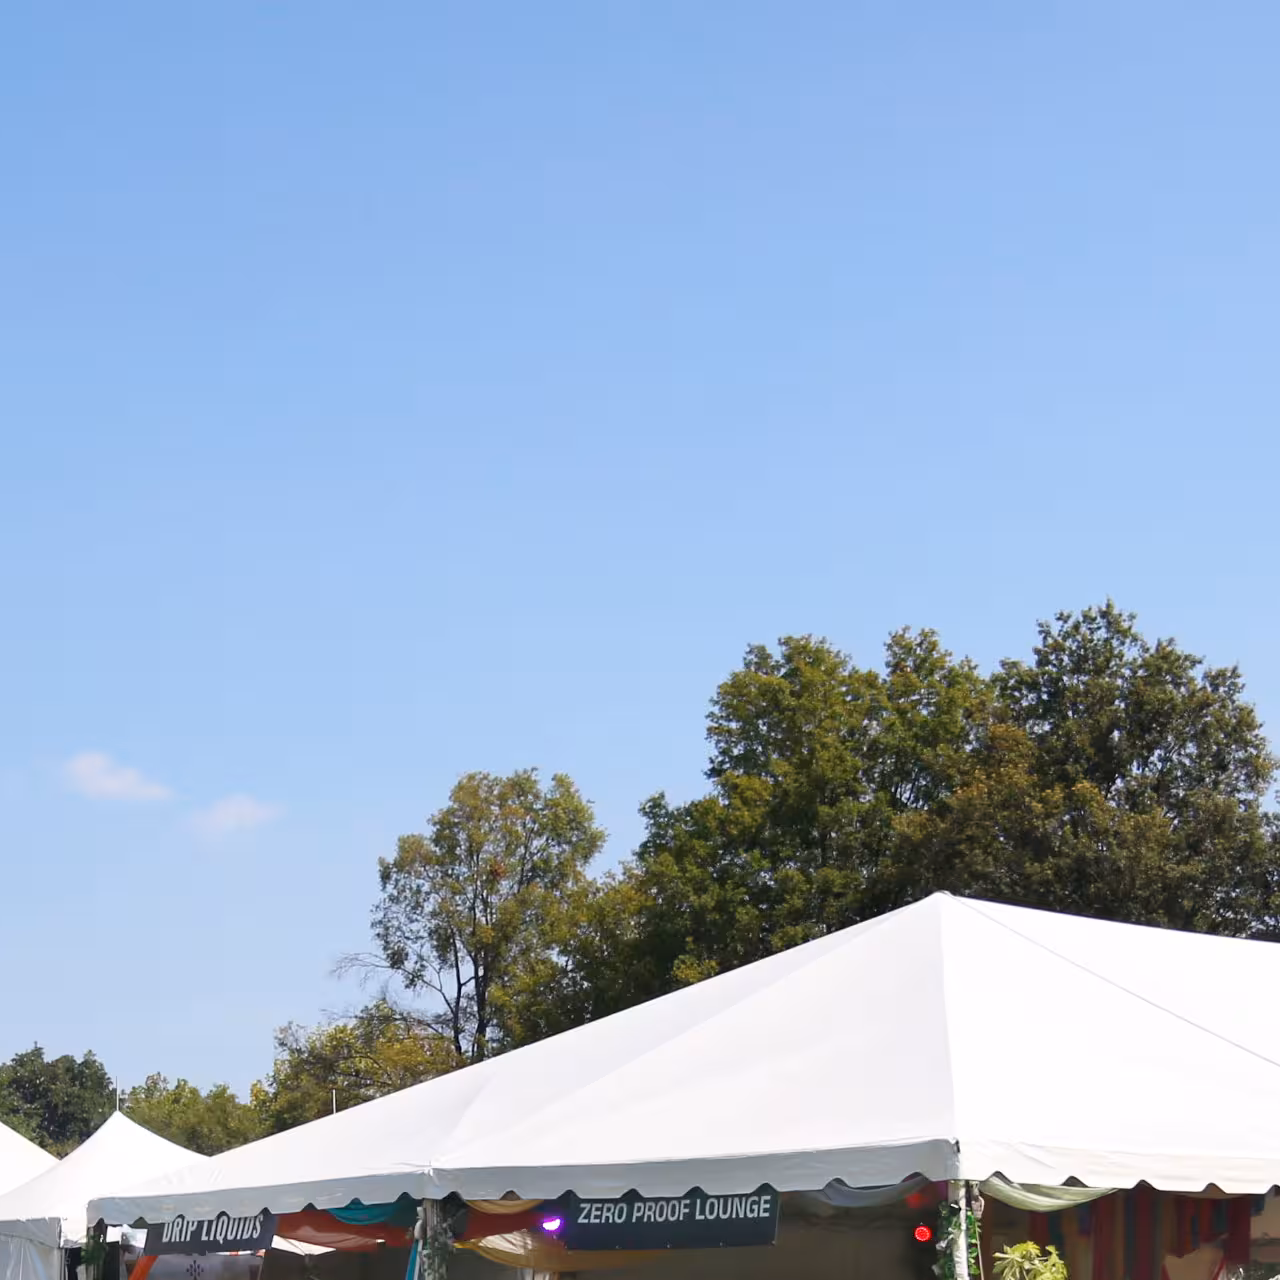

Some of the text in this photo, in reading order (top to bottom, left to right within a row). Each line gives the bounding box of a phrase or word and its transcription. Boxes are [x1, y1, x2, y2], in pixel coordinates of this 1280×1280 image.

[577, 1195, 772, 1224] ZERO PROOF LOUNGE
[162, 1214, 264, 1244] DRIP LIQUIDS
